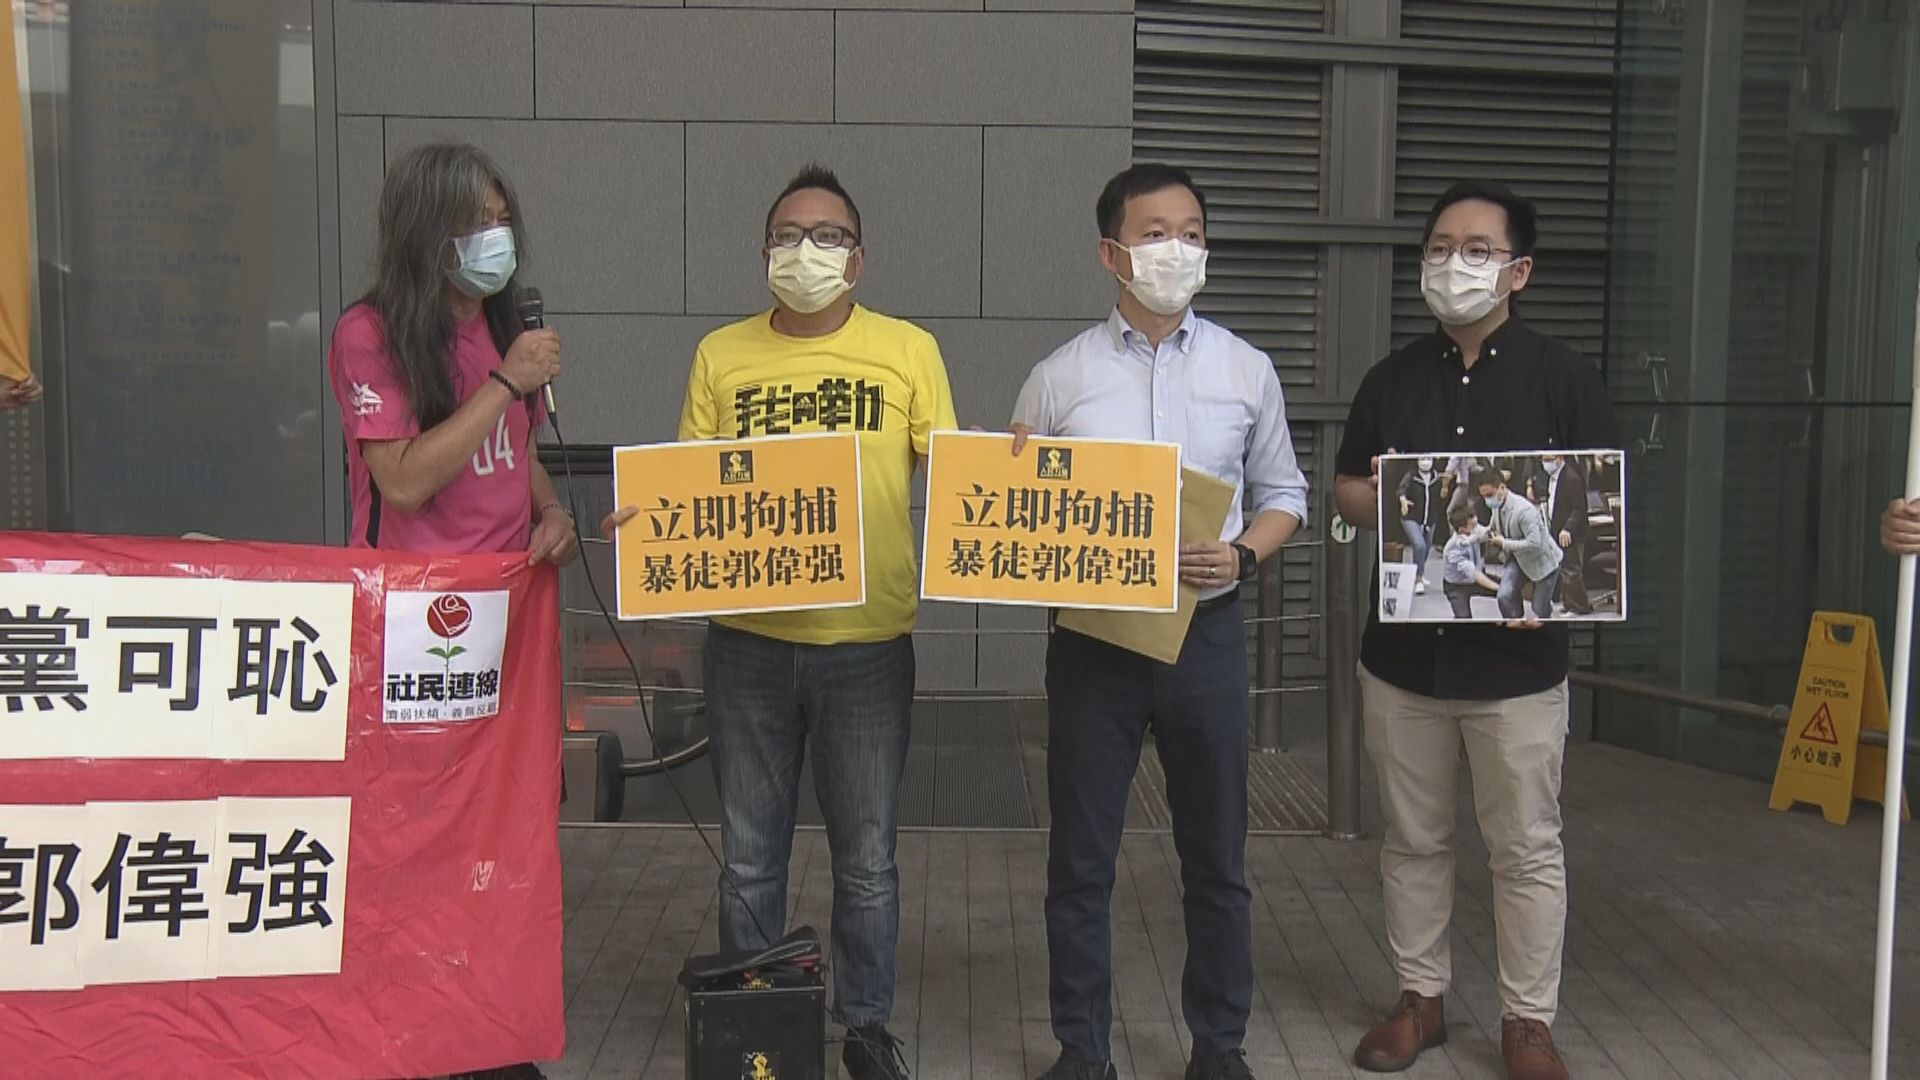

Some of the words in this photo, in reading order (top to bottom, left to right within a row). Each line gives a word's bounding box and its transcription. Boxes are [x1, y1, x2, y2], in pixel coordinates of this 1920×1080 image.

[642, 486, 837, 543] 立即拘捕
[951, 483, 1155, 539] 立即拘捕
[640, 543, 845, 594] 暴徒郭偉强
[945, 537, 1157, 588] 暴徒郭偉强
[0, 603, 339, 716] 黨可恥
[386, 667, 499, 702] 社民連線
[1812, 676, 1847, 689] CAUTION
[1806, 685, 1822, 696] WET
[1824, 689, 1850, 699] FLOOR
[1791, 744, 1842, 769] 小心地滑
[0, 827, 336, 945] 郭偉強
